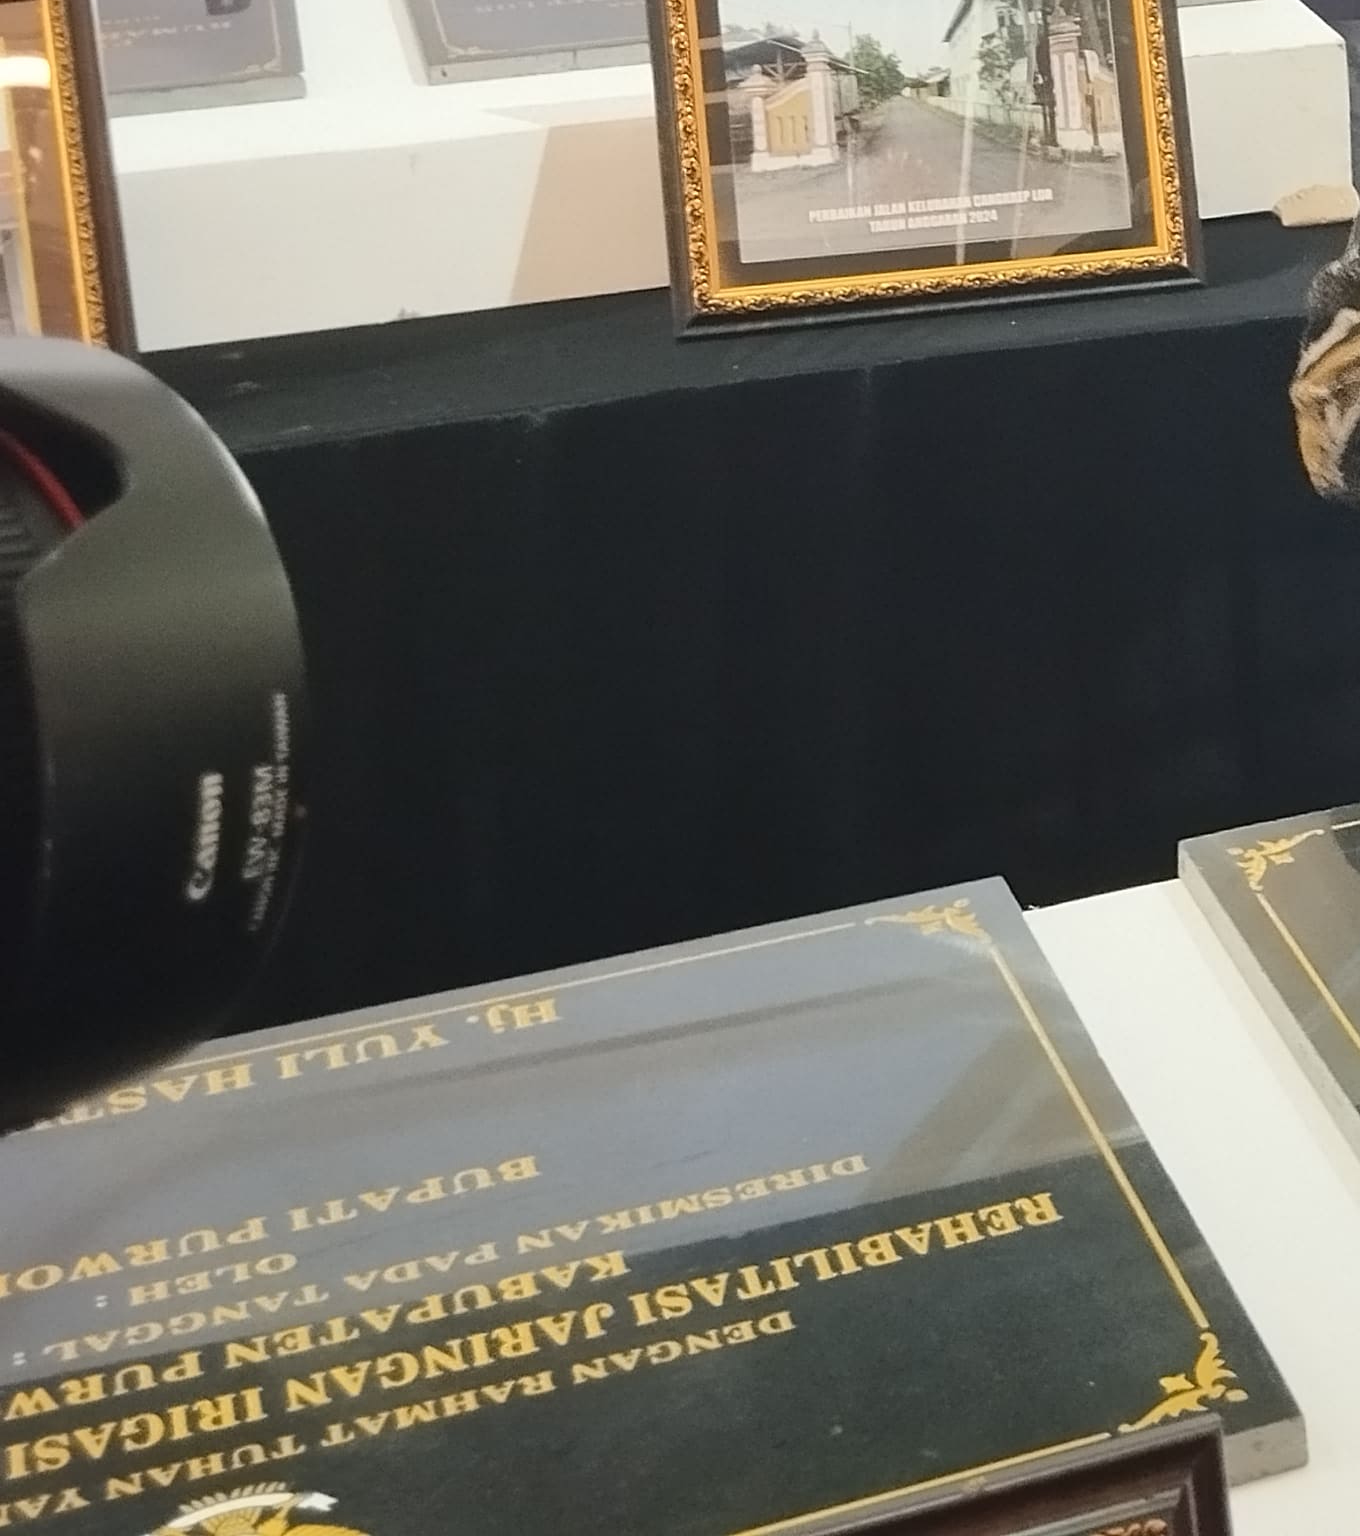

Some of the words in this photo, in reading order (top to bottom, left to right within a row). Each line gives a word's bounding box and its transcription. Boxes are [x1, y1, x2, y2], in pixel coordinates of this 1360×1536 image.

[186, 771, 224, 902] Canon
[276, 1023, 452, 1080] YULI
[463, 996, 563, 1035] Hj.
[287, 1154, 541, 1234] BUPATI
[515, 1154, 871, 1255] DIRESMIKAN
[0, 1215, 270, 1300] PURWO
[127, 1252, 299, 1308] OLEH
[343, 1240, 500, 1293] PADA
[627, 1191, 1065, 1328] REHABILITASI
[40, 1283, 331, 1362] TANGGAL
[224, 1249, 632, 1370] KABUPATEN
[571, 1310, 797, 1385] DENGAN
[285, 1302, 616, 1414] JARINGAN
[3, 1385, 270, 1481] IRIGASI
[320, 1369, 557, 1448] RAHMAT
[104, 1433, 307, 1501] TUHAN
[0, 1486, 92, 1528] YA
